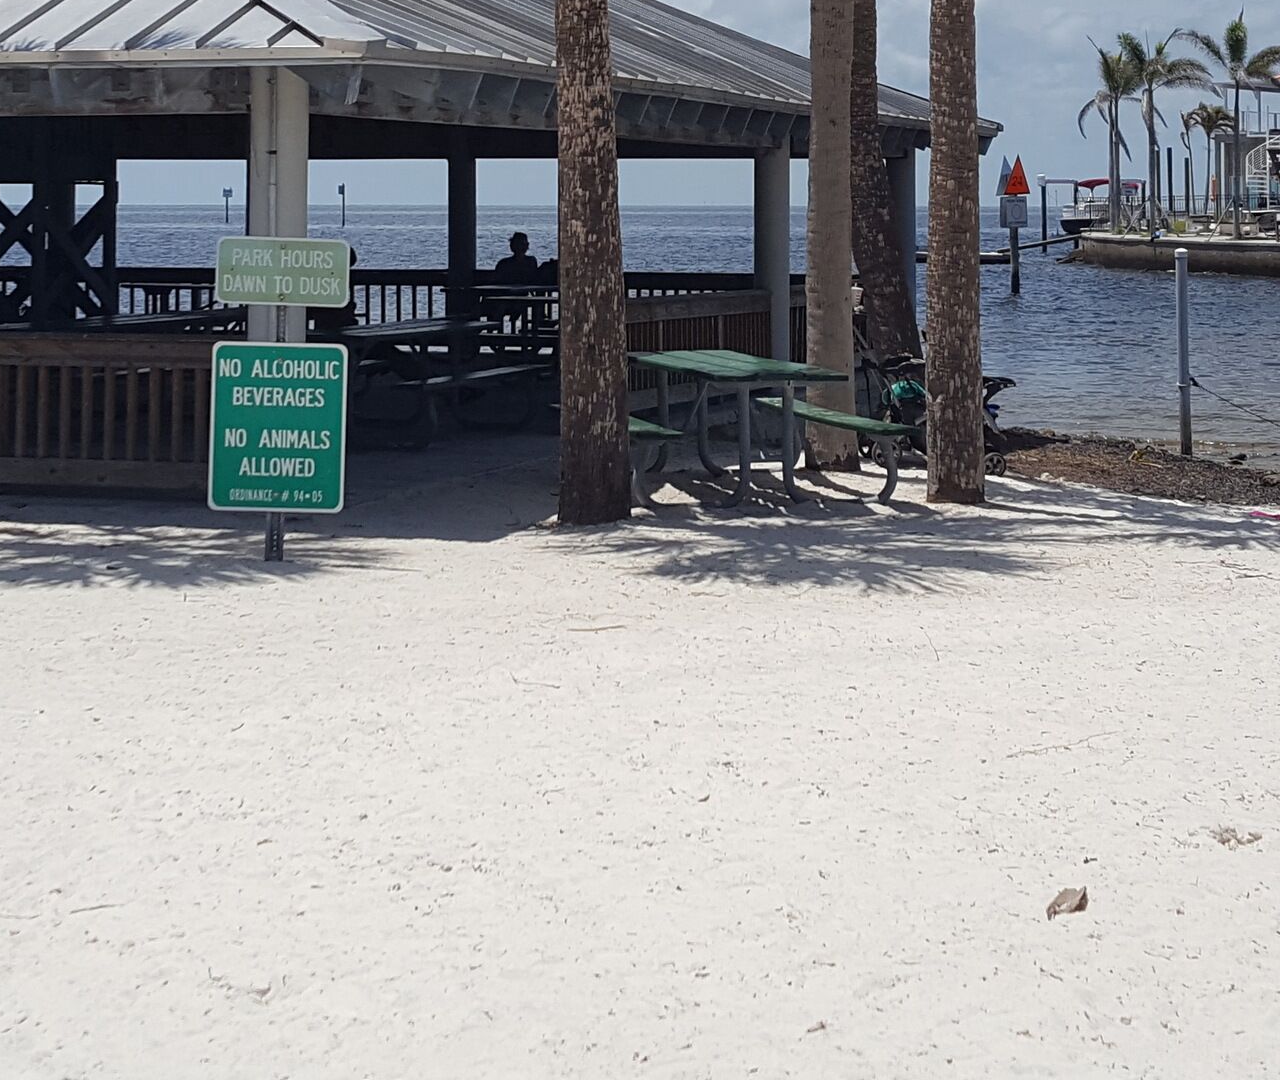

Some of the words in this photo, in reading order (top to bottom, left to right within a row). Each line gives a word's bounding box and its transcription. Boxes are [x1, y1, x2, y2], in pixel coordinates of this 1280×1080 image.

[232, 248, 273, 267] PARK
[280, 249, 334, 269] HOURS
[223, 274, 267, 293] DAWN
[273, 276, 293, 294] TO
[300, 277, 341, 296] DUSK
[219, 358, 242, 377] NO
[251, 359, 340, 380] ALCOHOLIC
[232, 386, 325, 408] BEVERAGES
[224, 428, 247, 448] NO
[258, 429, 331, 450] ANIMALS
[238, 457, 315, 477] ALLOWED
